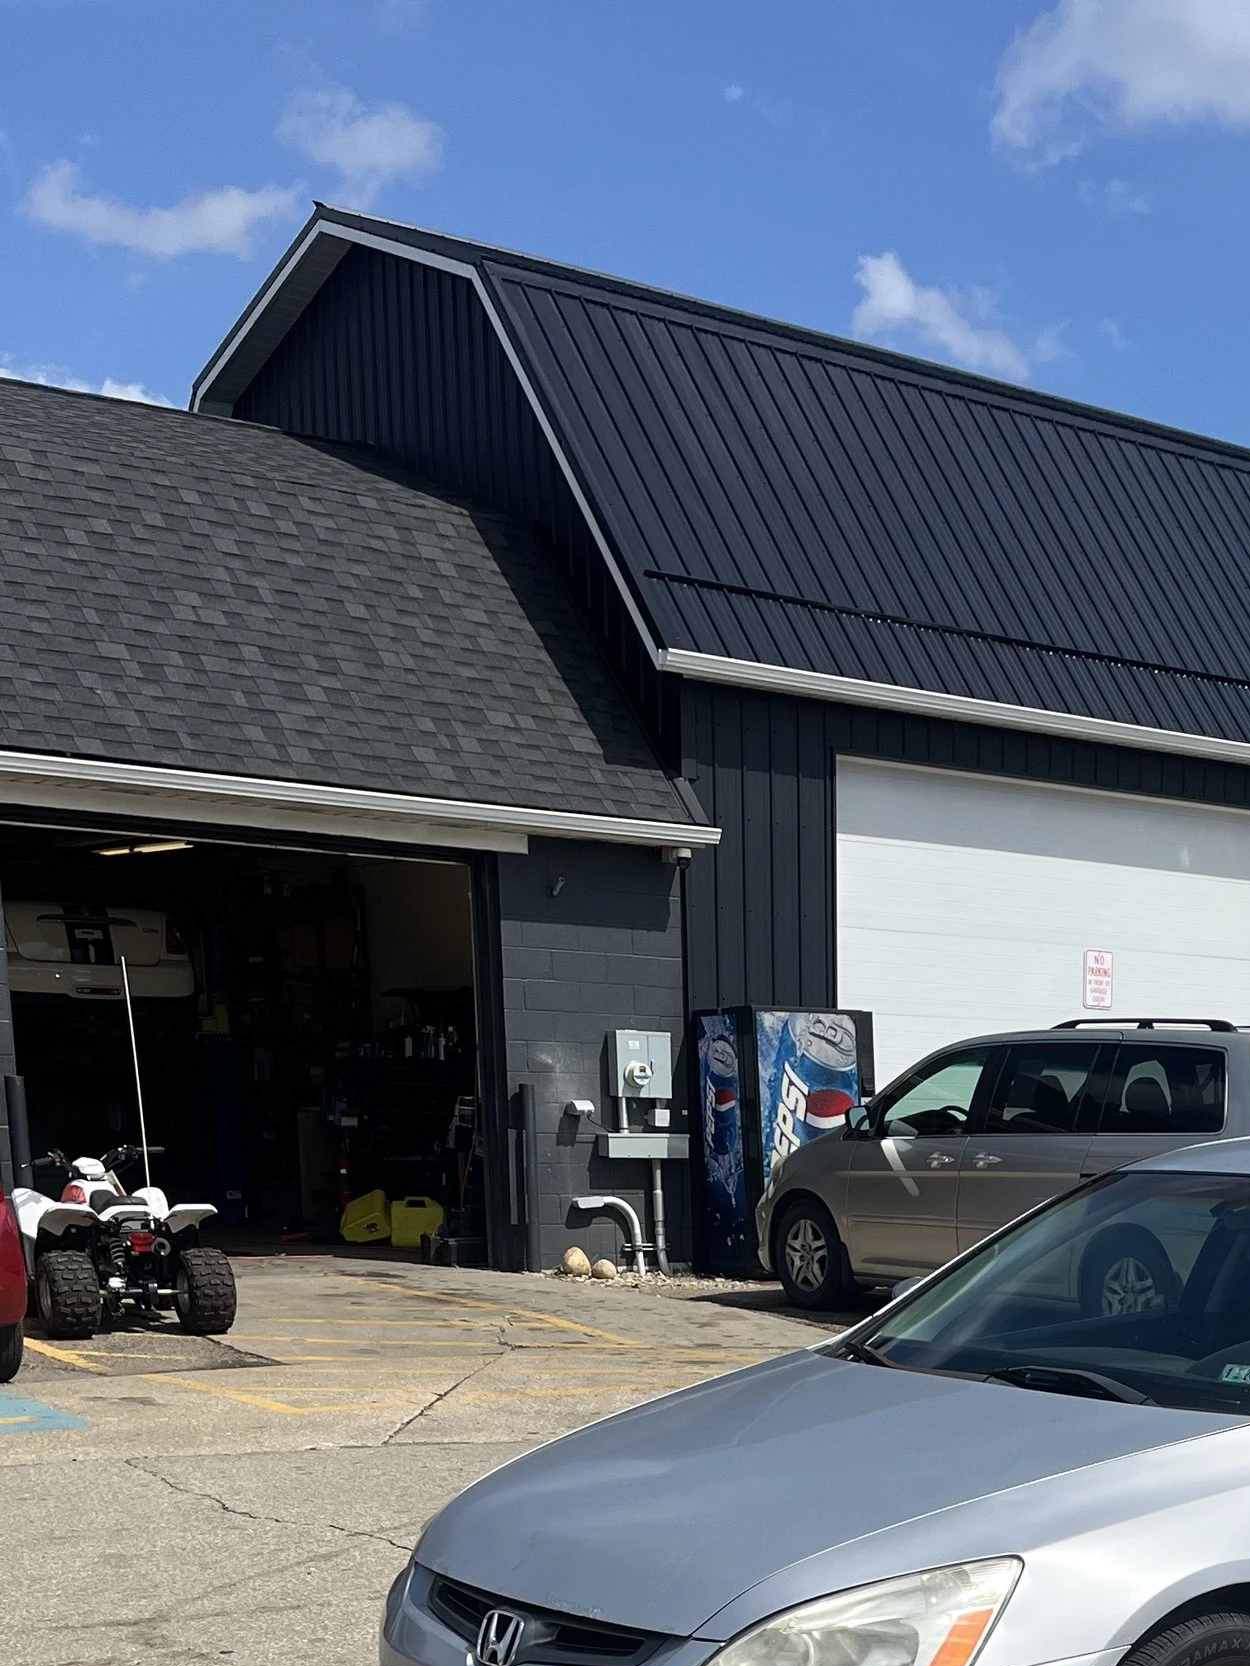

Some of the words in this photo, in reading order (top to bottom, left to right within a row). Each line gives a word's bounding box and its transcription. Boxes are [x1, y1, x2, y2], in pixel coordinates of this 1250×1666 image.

[1094, 955, 1105, 966] NO
[1088, 966, 1111, 978] PARKING
[770, 1060, 809, 1169] EPSI
